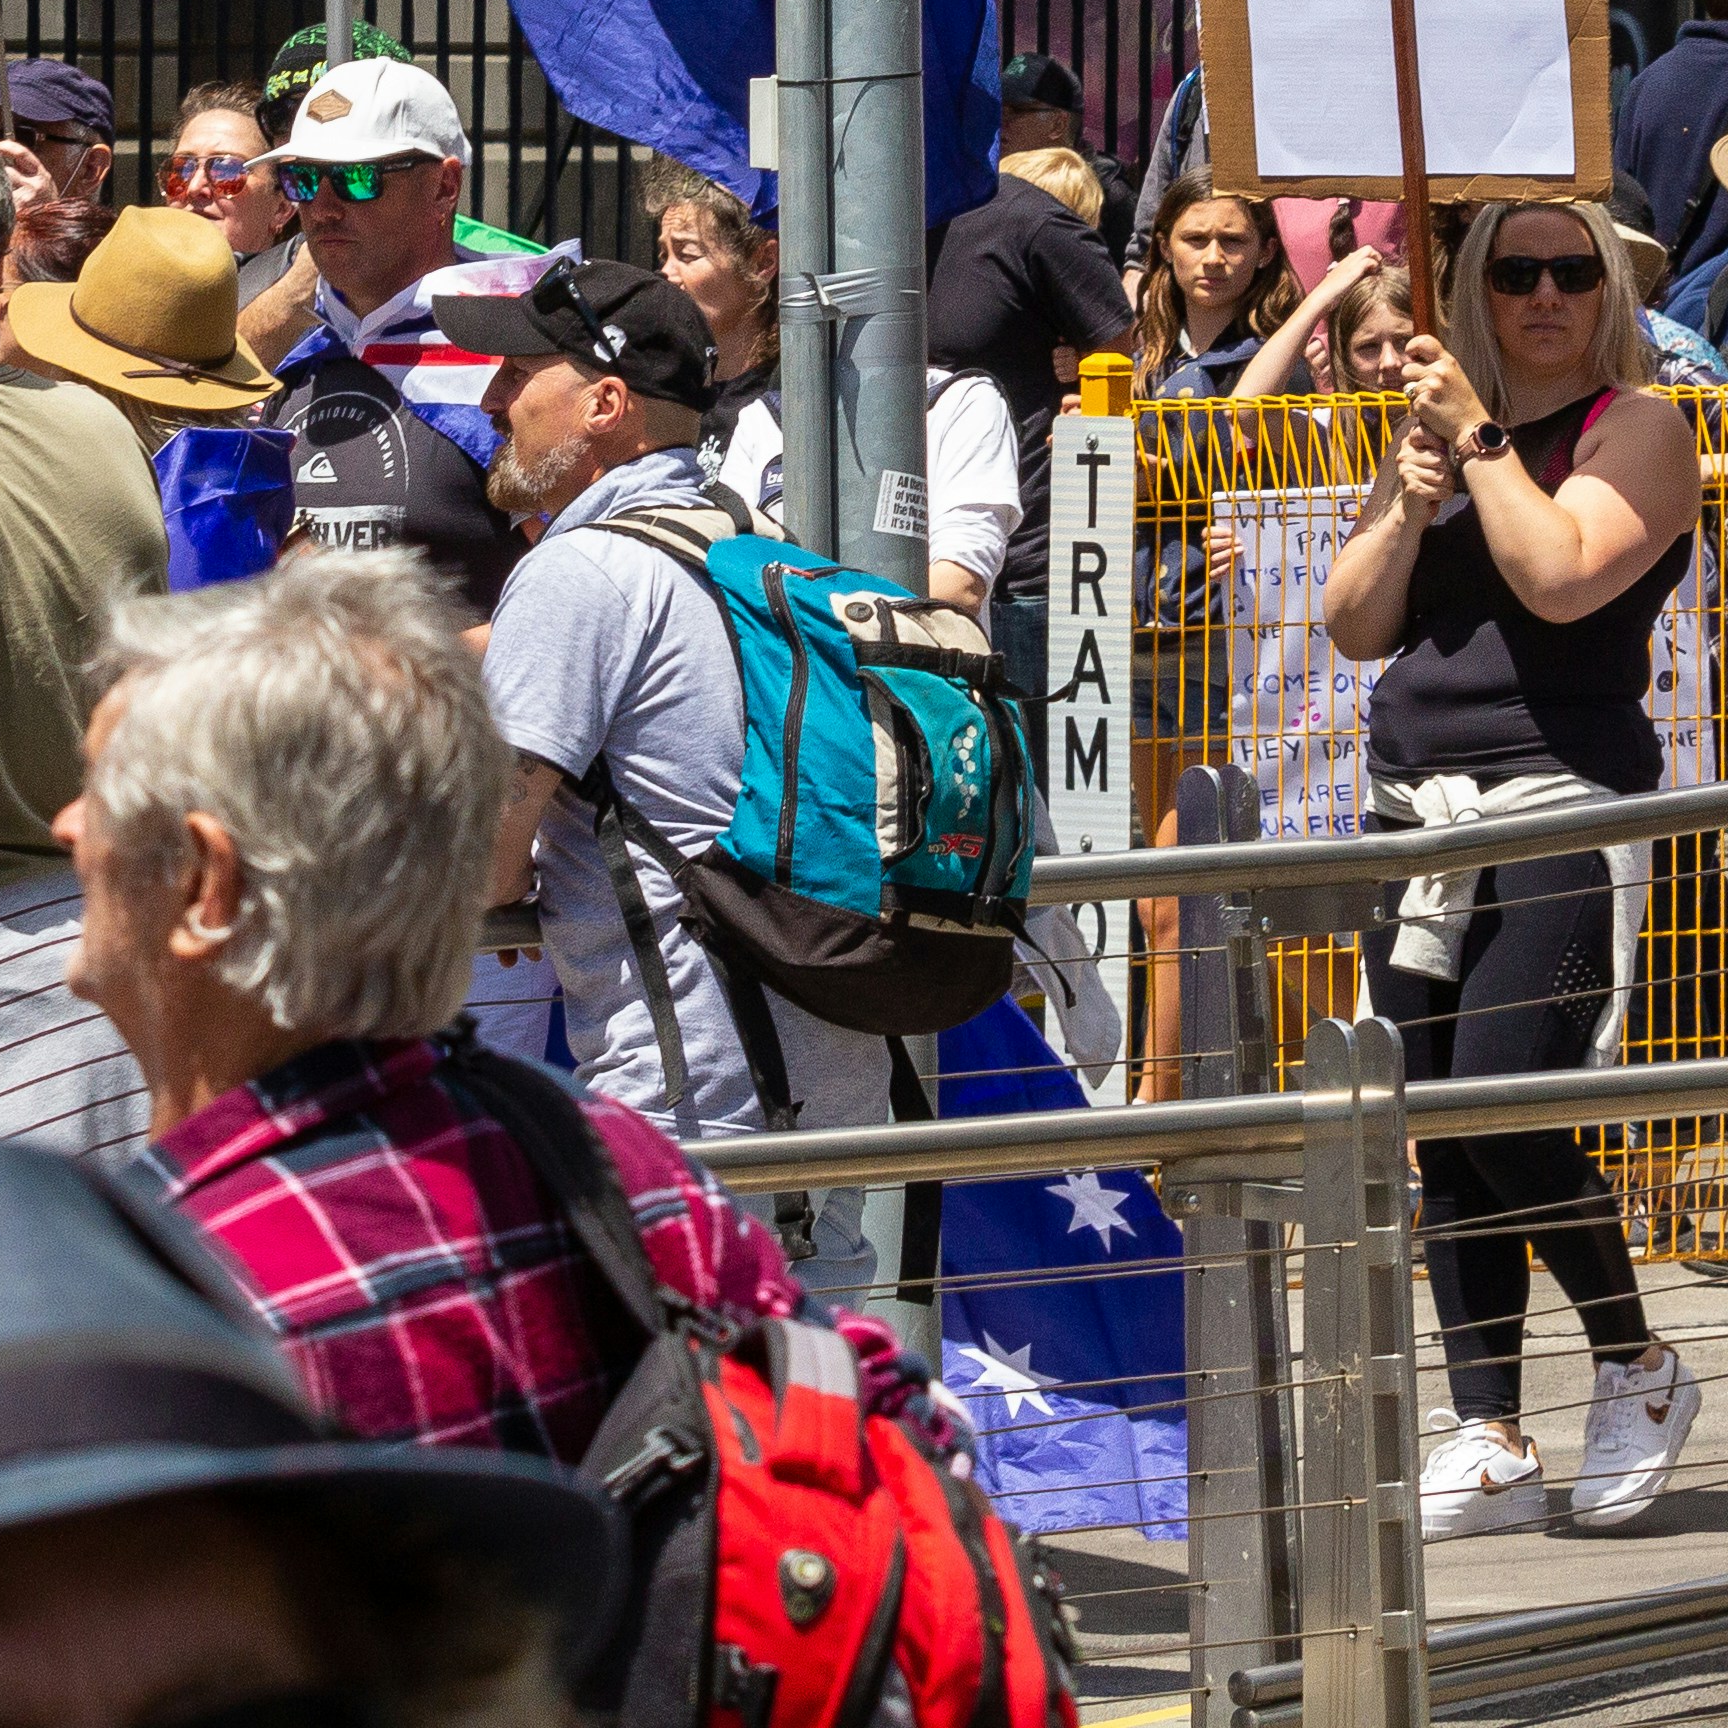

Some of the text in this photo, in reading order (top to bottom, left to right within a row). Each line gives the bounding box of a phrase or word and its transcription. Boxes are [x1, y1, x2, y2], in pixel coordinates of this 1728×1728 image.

[1236, 500, 1301, 530] WE
[1243, 669, 1323, 695] COME
[1240, 737, 1301, 763] HEY
